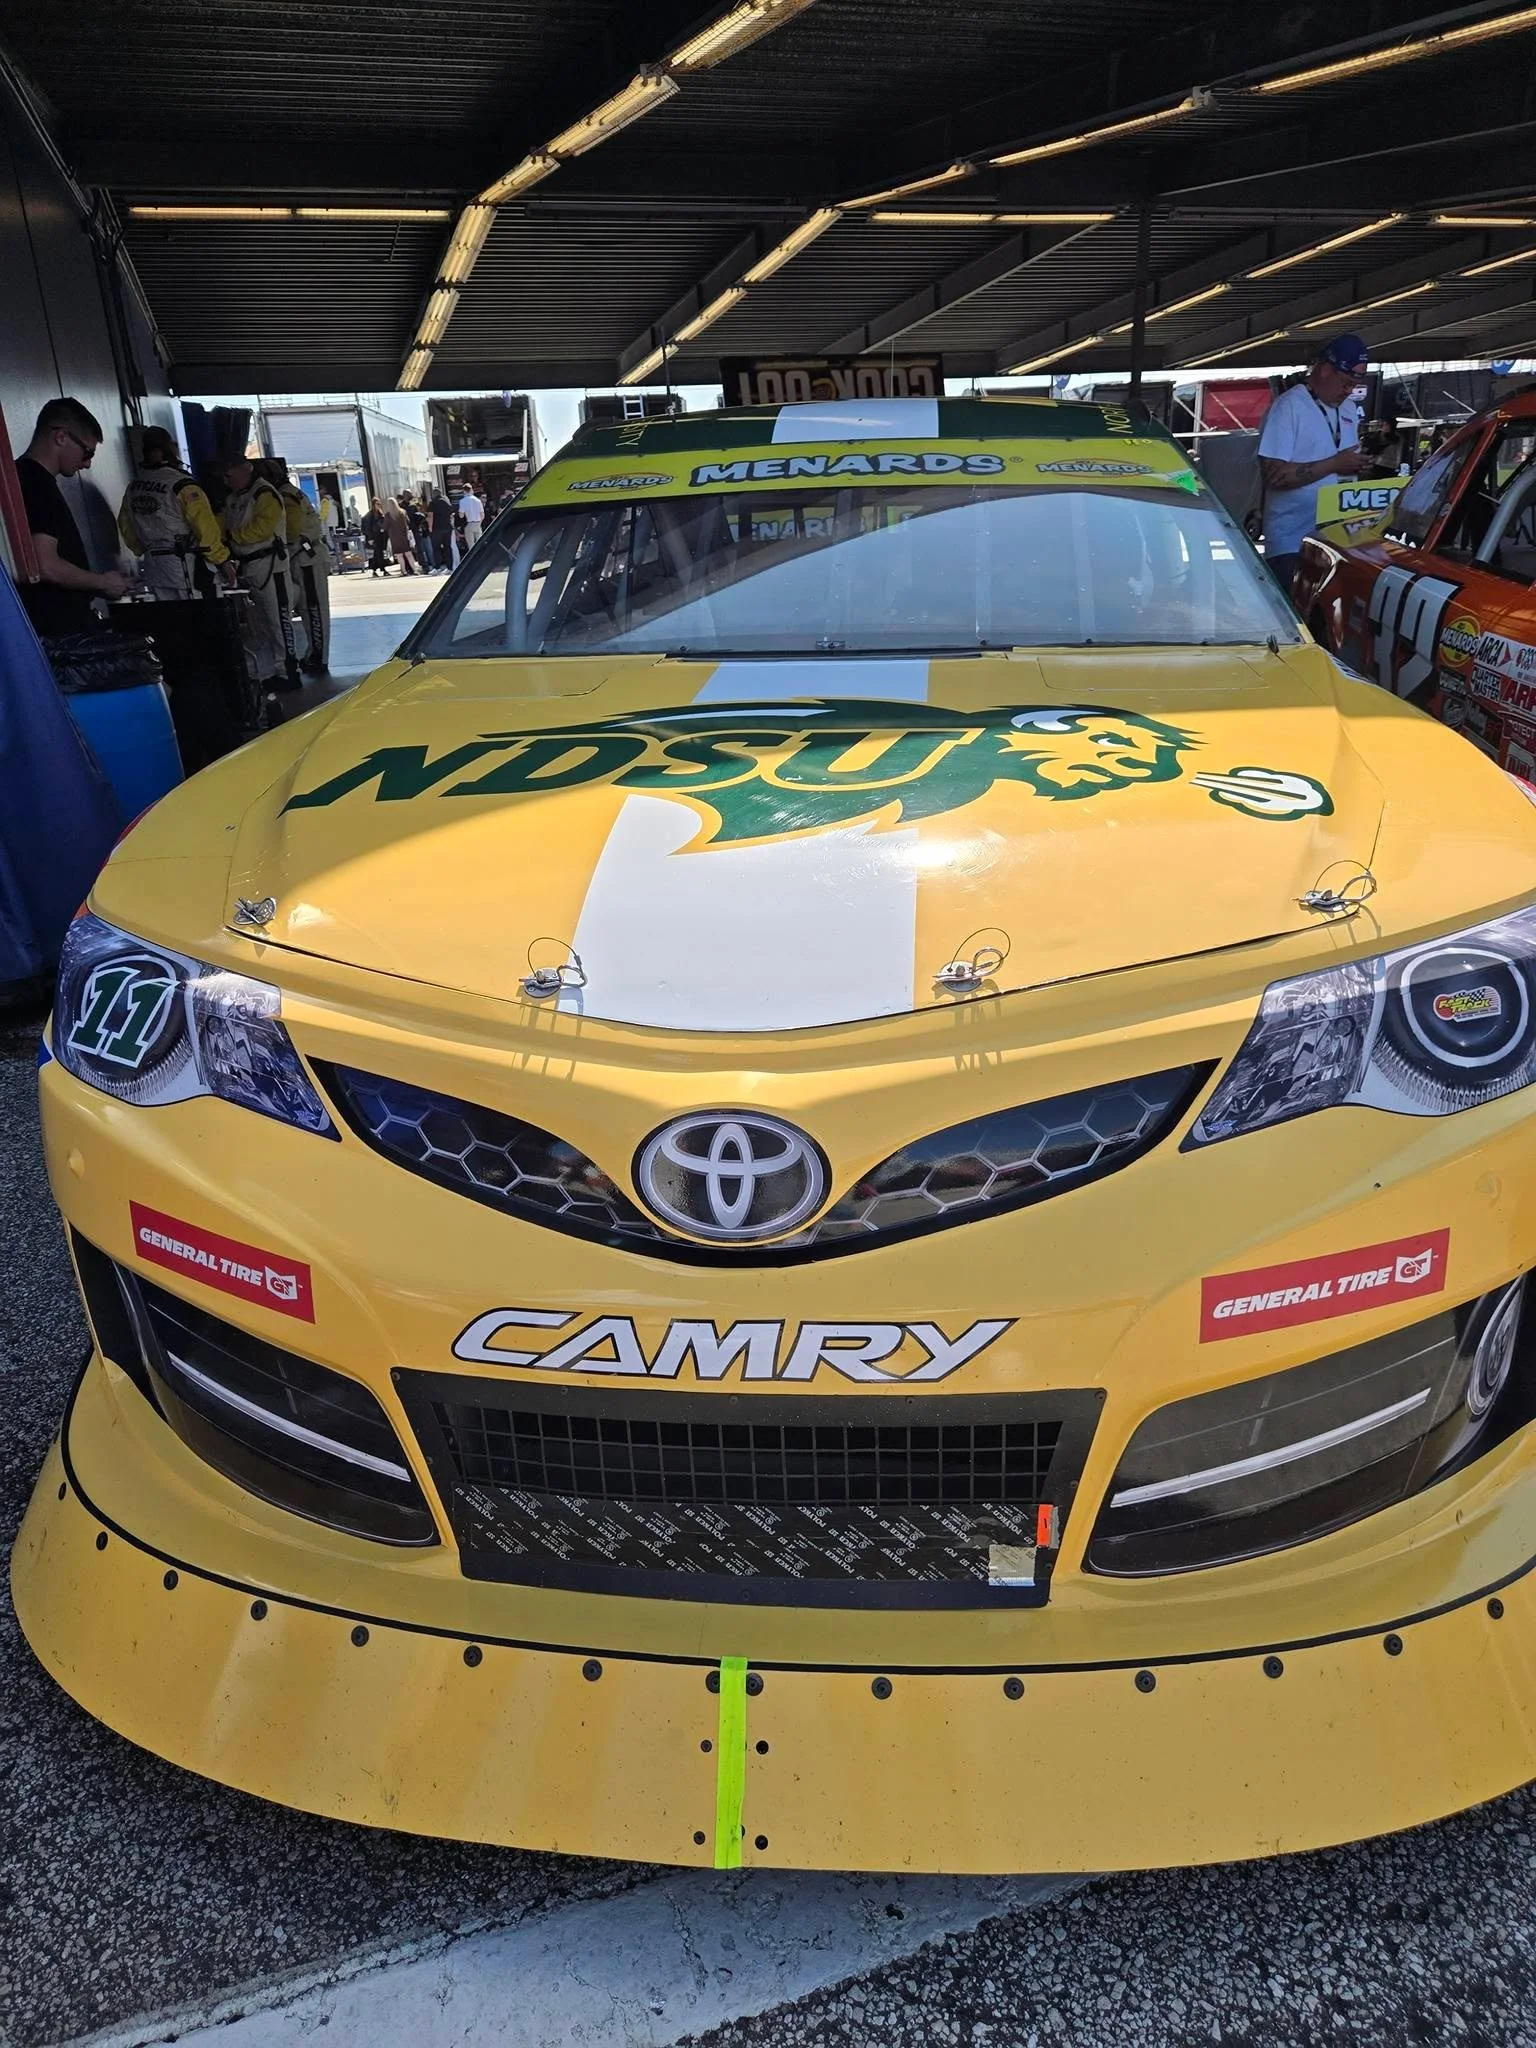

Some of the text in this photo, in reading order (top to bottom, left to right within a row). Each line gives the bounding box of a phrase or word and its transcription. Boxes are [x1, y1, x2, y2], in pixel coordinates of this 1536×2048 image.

[567, 476, 674, 491] MENARDS
[689, 452, 1006, 487] MENARDS
[1037, 462, 1152, 474] MENARDS
[1439, 627, 1481, 655] MENARDS
[278, 727, 985, 815] NDSU
[67, 967, 181, 1068] 11
[139, 1227, 218, 1271] GENERAL
[219, 1258, 263, 1287] TIRE
[1212, 1280, 1333, 1319] GENERAL
[1337, 1266, 1394, 1295] TIRE
[451, 1307, 1019, 1383] CAMRY
